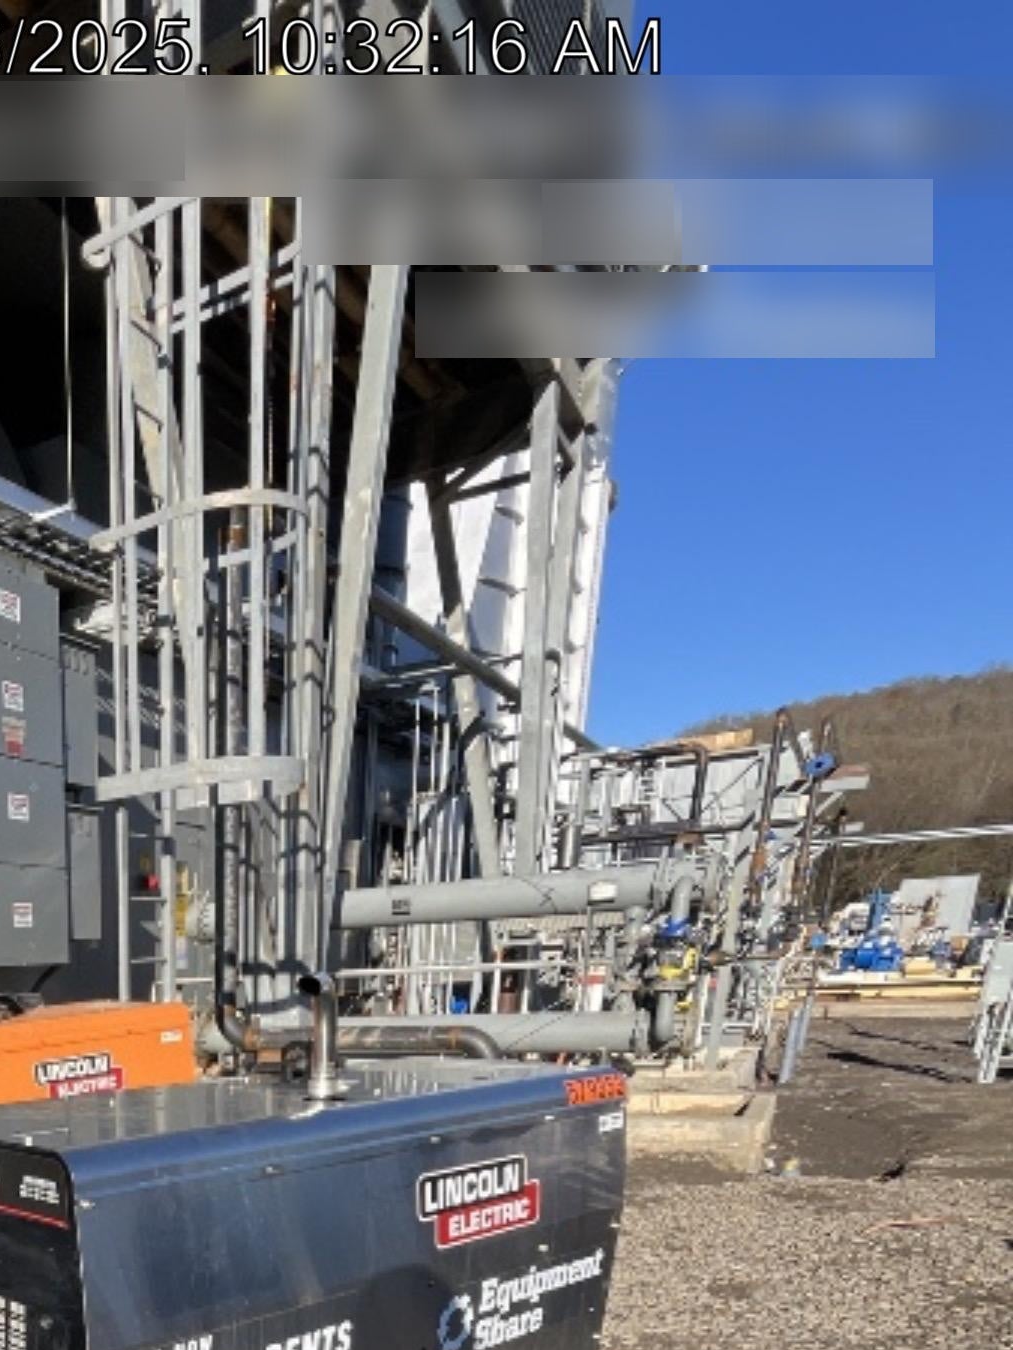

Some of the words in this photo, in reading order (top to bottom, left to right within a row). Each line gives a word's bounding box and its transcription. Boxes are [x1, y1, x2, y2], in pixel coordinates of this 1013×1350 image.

[37, 1055, 109, 1083] LINCOLN
[424, 1163, 520, 1213] LINCOLN
[448, 1198, 531, 1239] ELECTRIC
[479, 1248, 604, 1313] Equipment
[474, 1307, 544, 1350] Share
